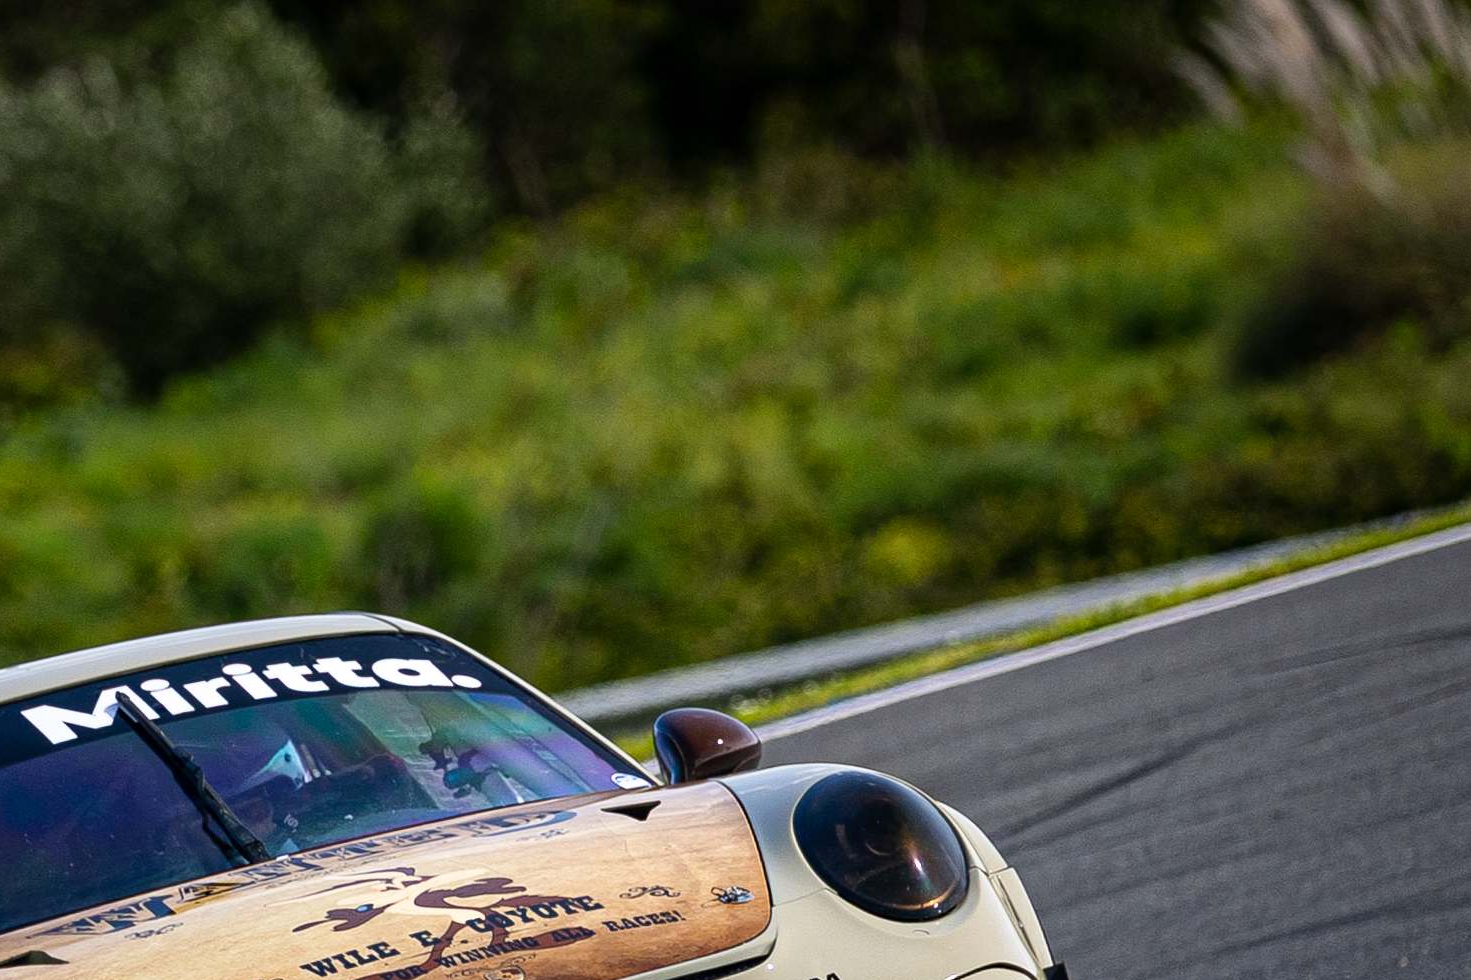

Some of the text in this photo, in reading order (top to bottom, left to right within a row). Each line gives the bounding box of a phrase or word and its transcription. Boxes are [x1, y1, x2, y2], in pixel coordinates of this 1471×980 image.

[20, 657, 482, 745] Miritta.
[299, 941, 401, 978] WILE
[466, 895, 605, 933] COYOTE
[435, 936, 538, 968] WINNING
[602, 910, 686, 932] RACES!
